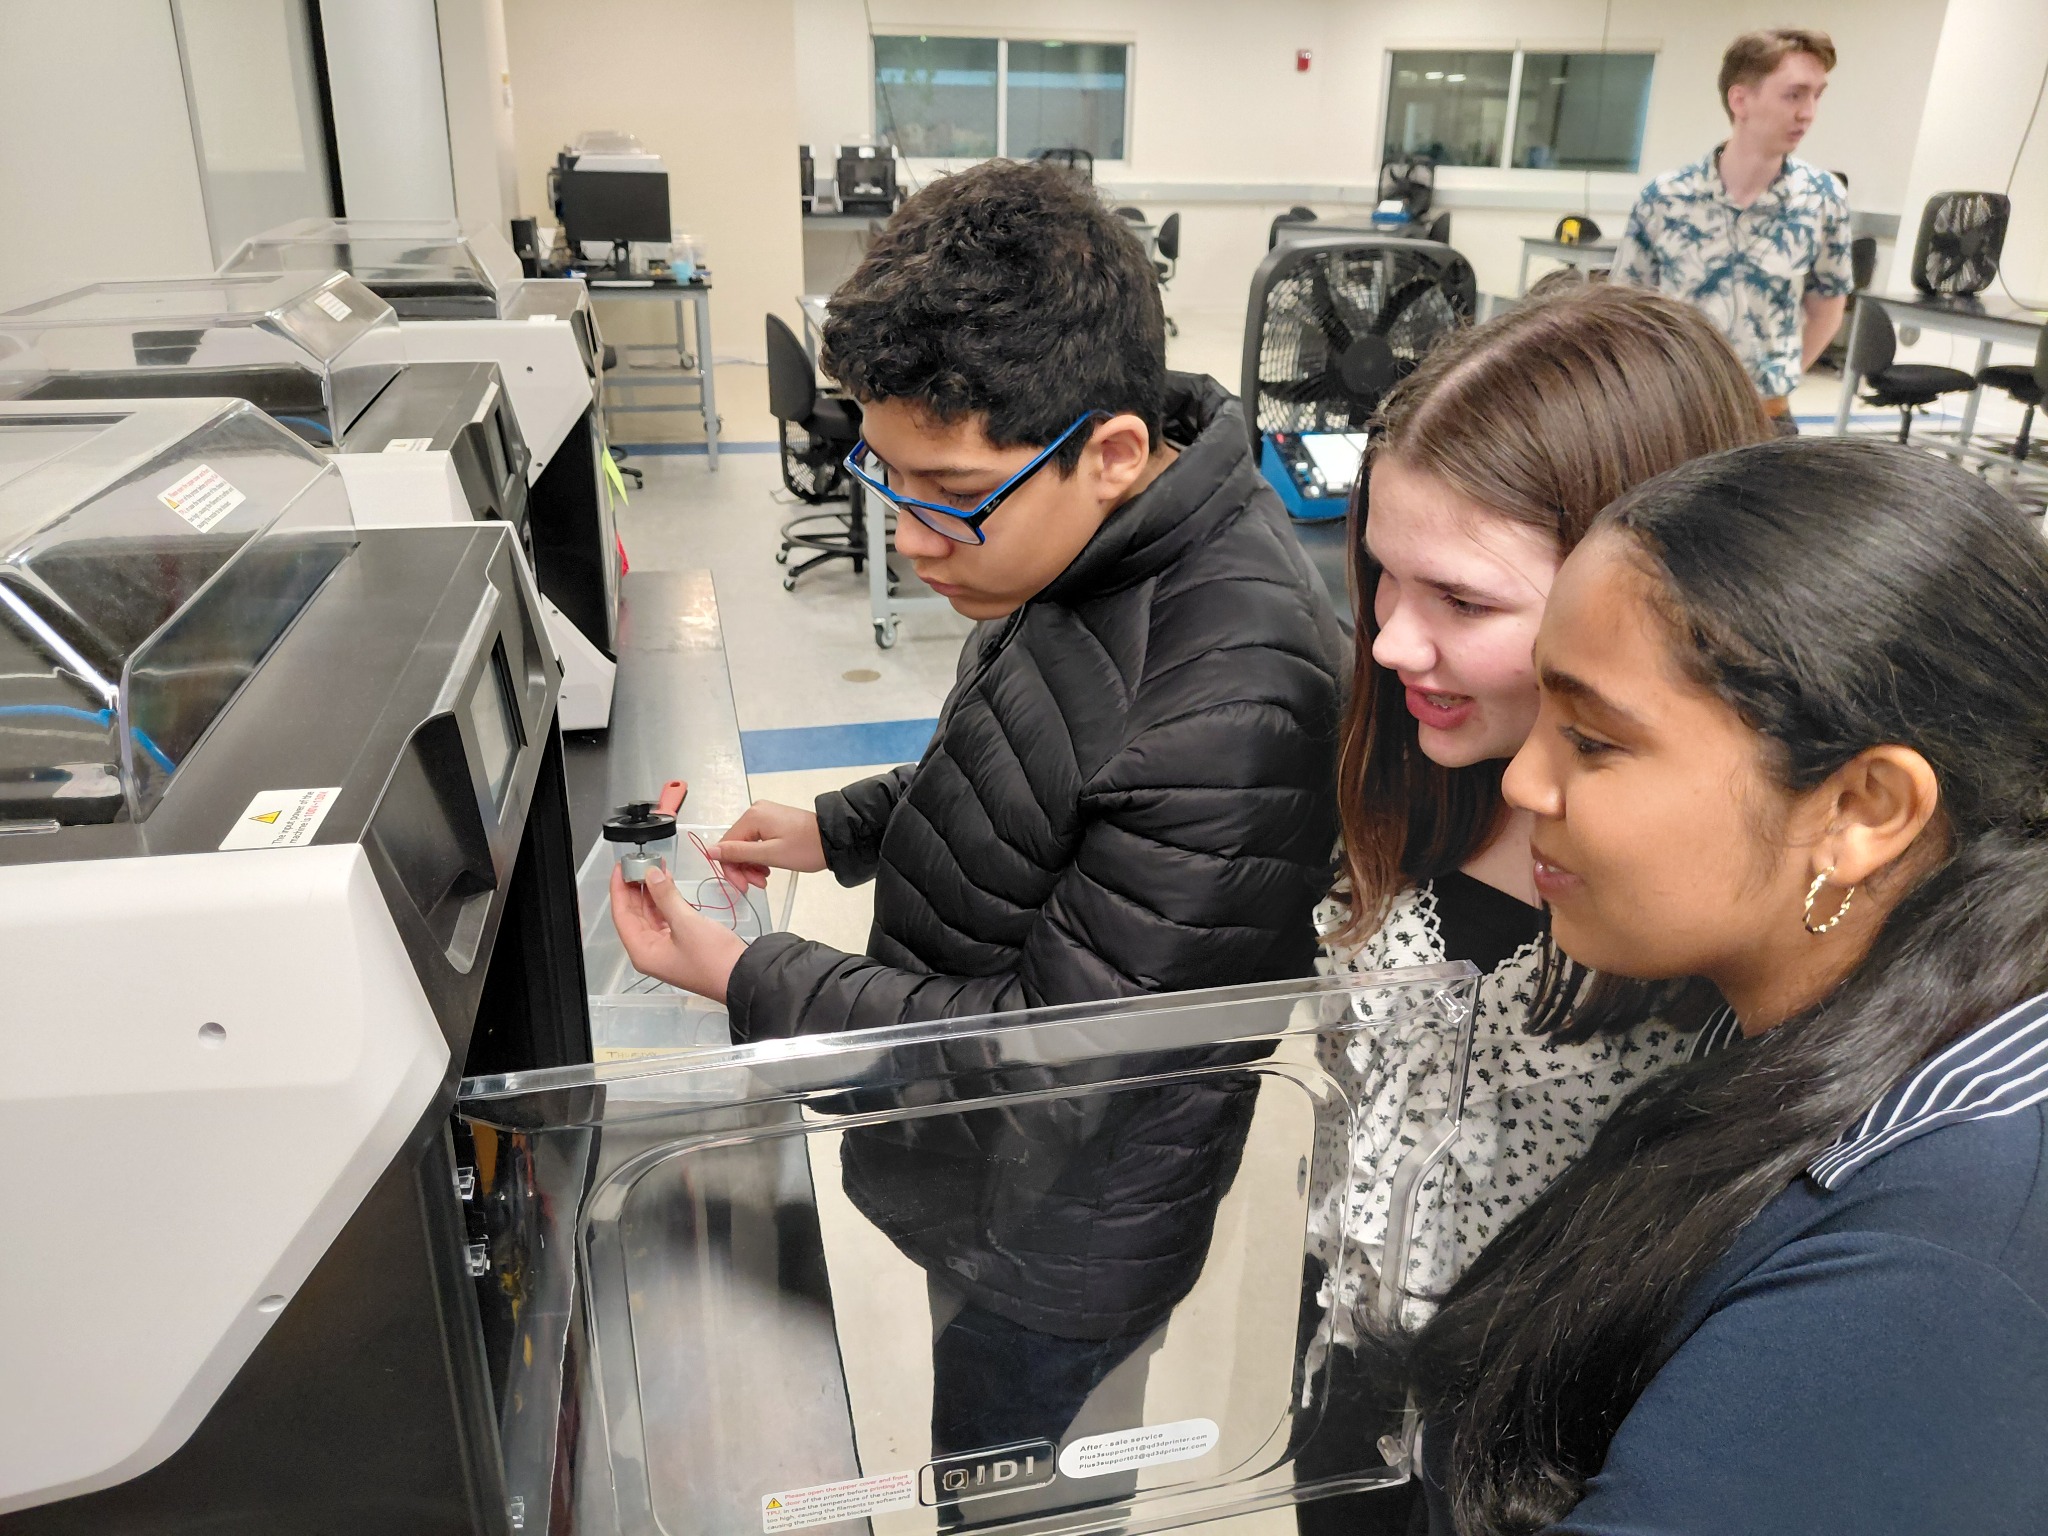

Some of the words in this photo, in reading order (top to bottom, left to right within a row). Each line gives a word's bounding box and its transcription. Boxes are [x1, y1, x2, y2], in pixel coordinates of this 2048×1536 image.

[272, 834, 286, 844] The
[1080, 1442, 1103, 1453] After
[1131, 1433, 1164, 1443] service
[943, 1455, 1034, 1491] QIDI
[823, 1492, 845, 1501] printer
[870, 1483, 895, 1492] printing
[820, 1497, 860, 1507] temperature
